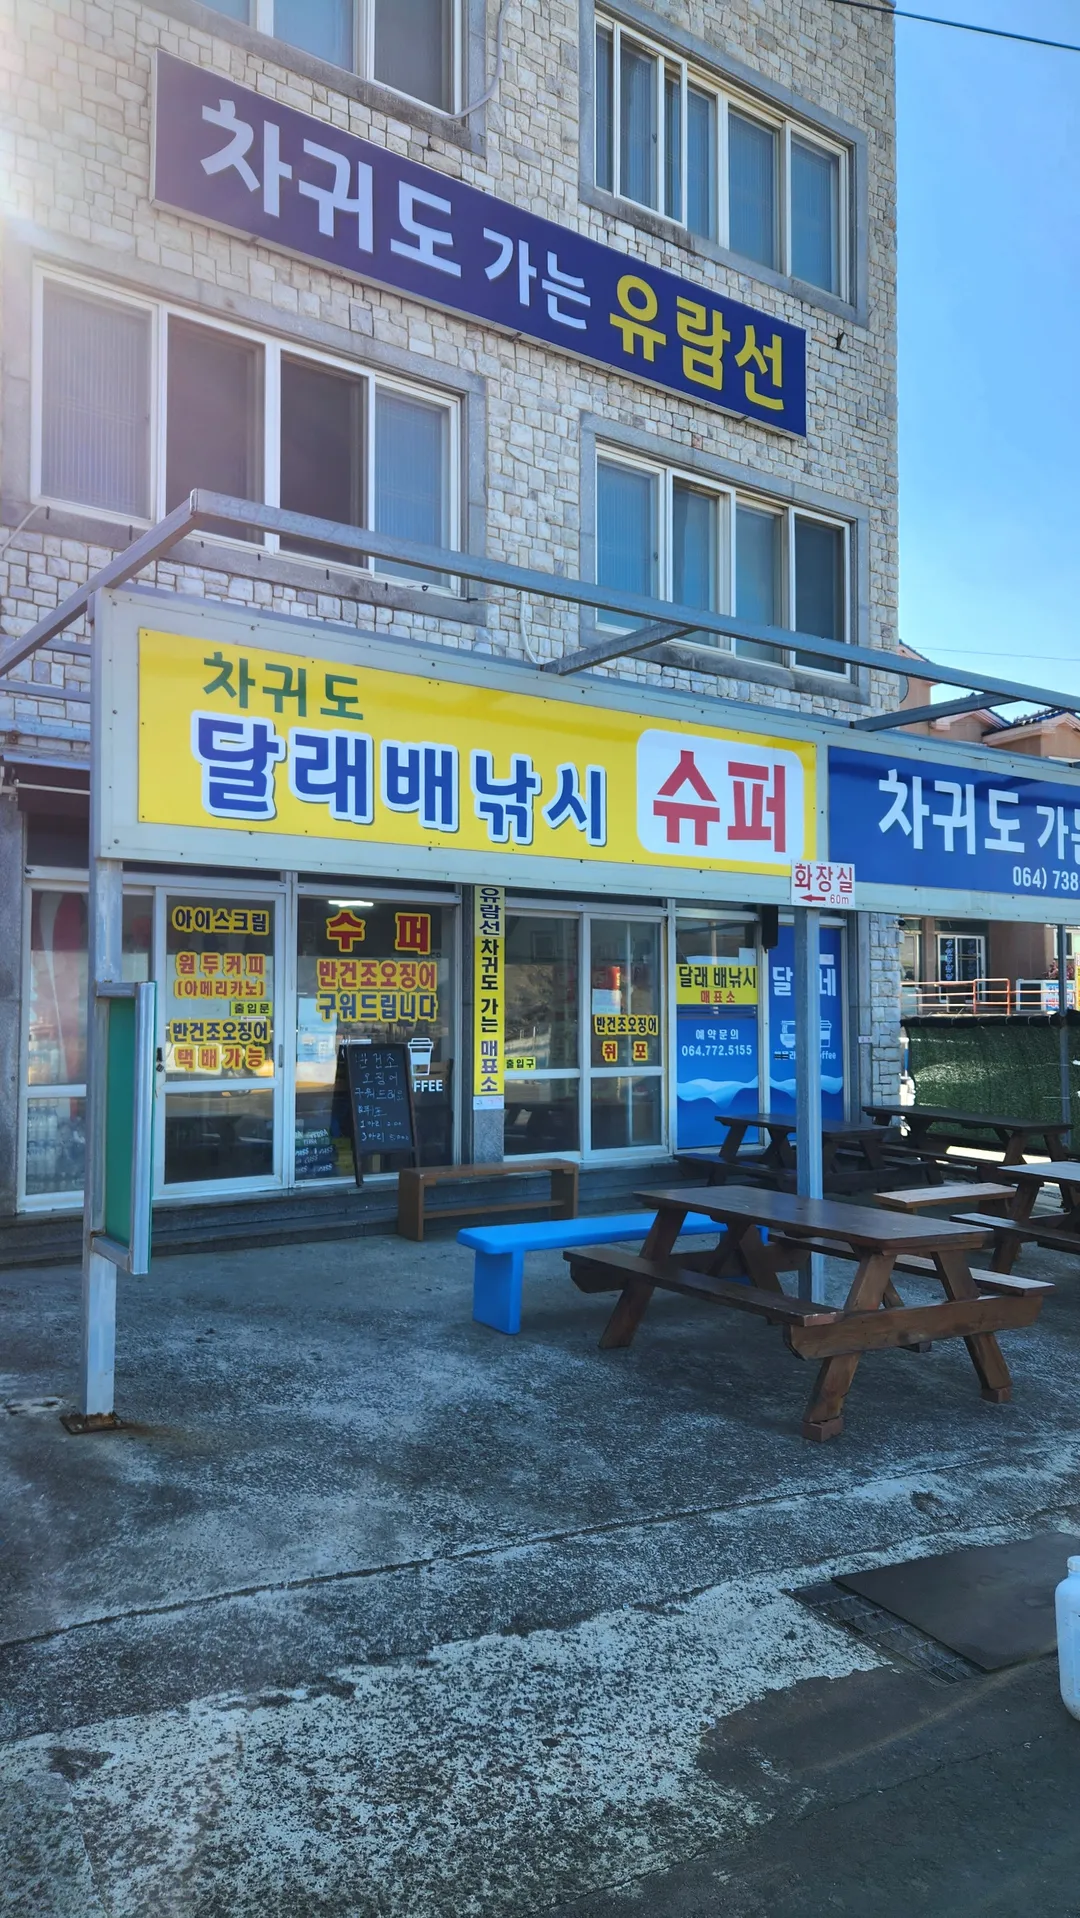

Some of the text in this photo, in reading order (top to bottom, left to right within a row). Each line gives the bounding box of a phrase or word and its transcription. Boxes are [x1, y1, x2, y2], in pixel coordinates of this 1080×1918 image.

[199, 97, 785, 411] 차귀도 가는 유람선
[202, 651, 364, 721] 차귀도
[192, 711, 787, 853] 달래배낚시 슈퍼
[878, 768, 1025, 855] 차귀도
[794, 863, 853, 893] 화장실
[1012, 866, 1047, 890] 064)
[830, 894, 849, 904] 60m
[174, 907, 267, 933] 아이스크림
[178, 953, 265, 975] 원두커피
[318, 960, 436, 990] 반건조오징어
[479, 887, 500, 1092] 유람선 차귀도 가는 매표소
[772, 966, 836, 996] 달네
[318, 992, 437, 1020] 구워드립니다
[700, 989, 736, 1003] 매표소
[233, 1002, 270, 1015] 출입문
[172, 1021, 268, 1042] 반건조오징어
[596, 1015, 657, 1034] 반건조오징어
[695, 1029, 739, 1041] 예약문의
[681, 1044, 753, 1057] 064.772.5155
[506, 1058, 535, 1070] 출입구
[362, 1071, 398, 1086] 오징어
[412, 1079, 443, 1093] FFEE
